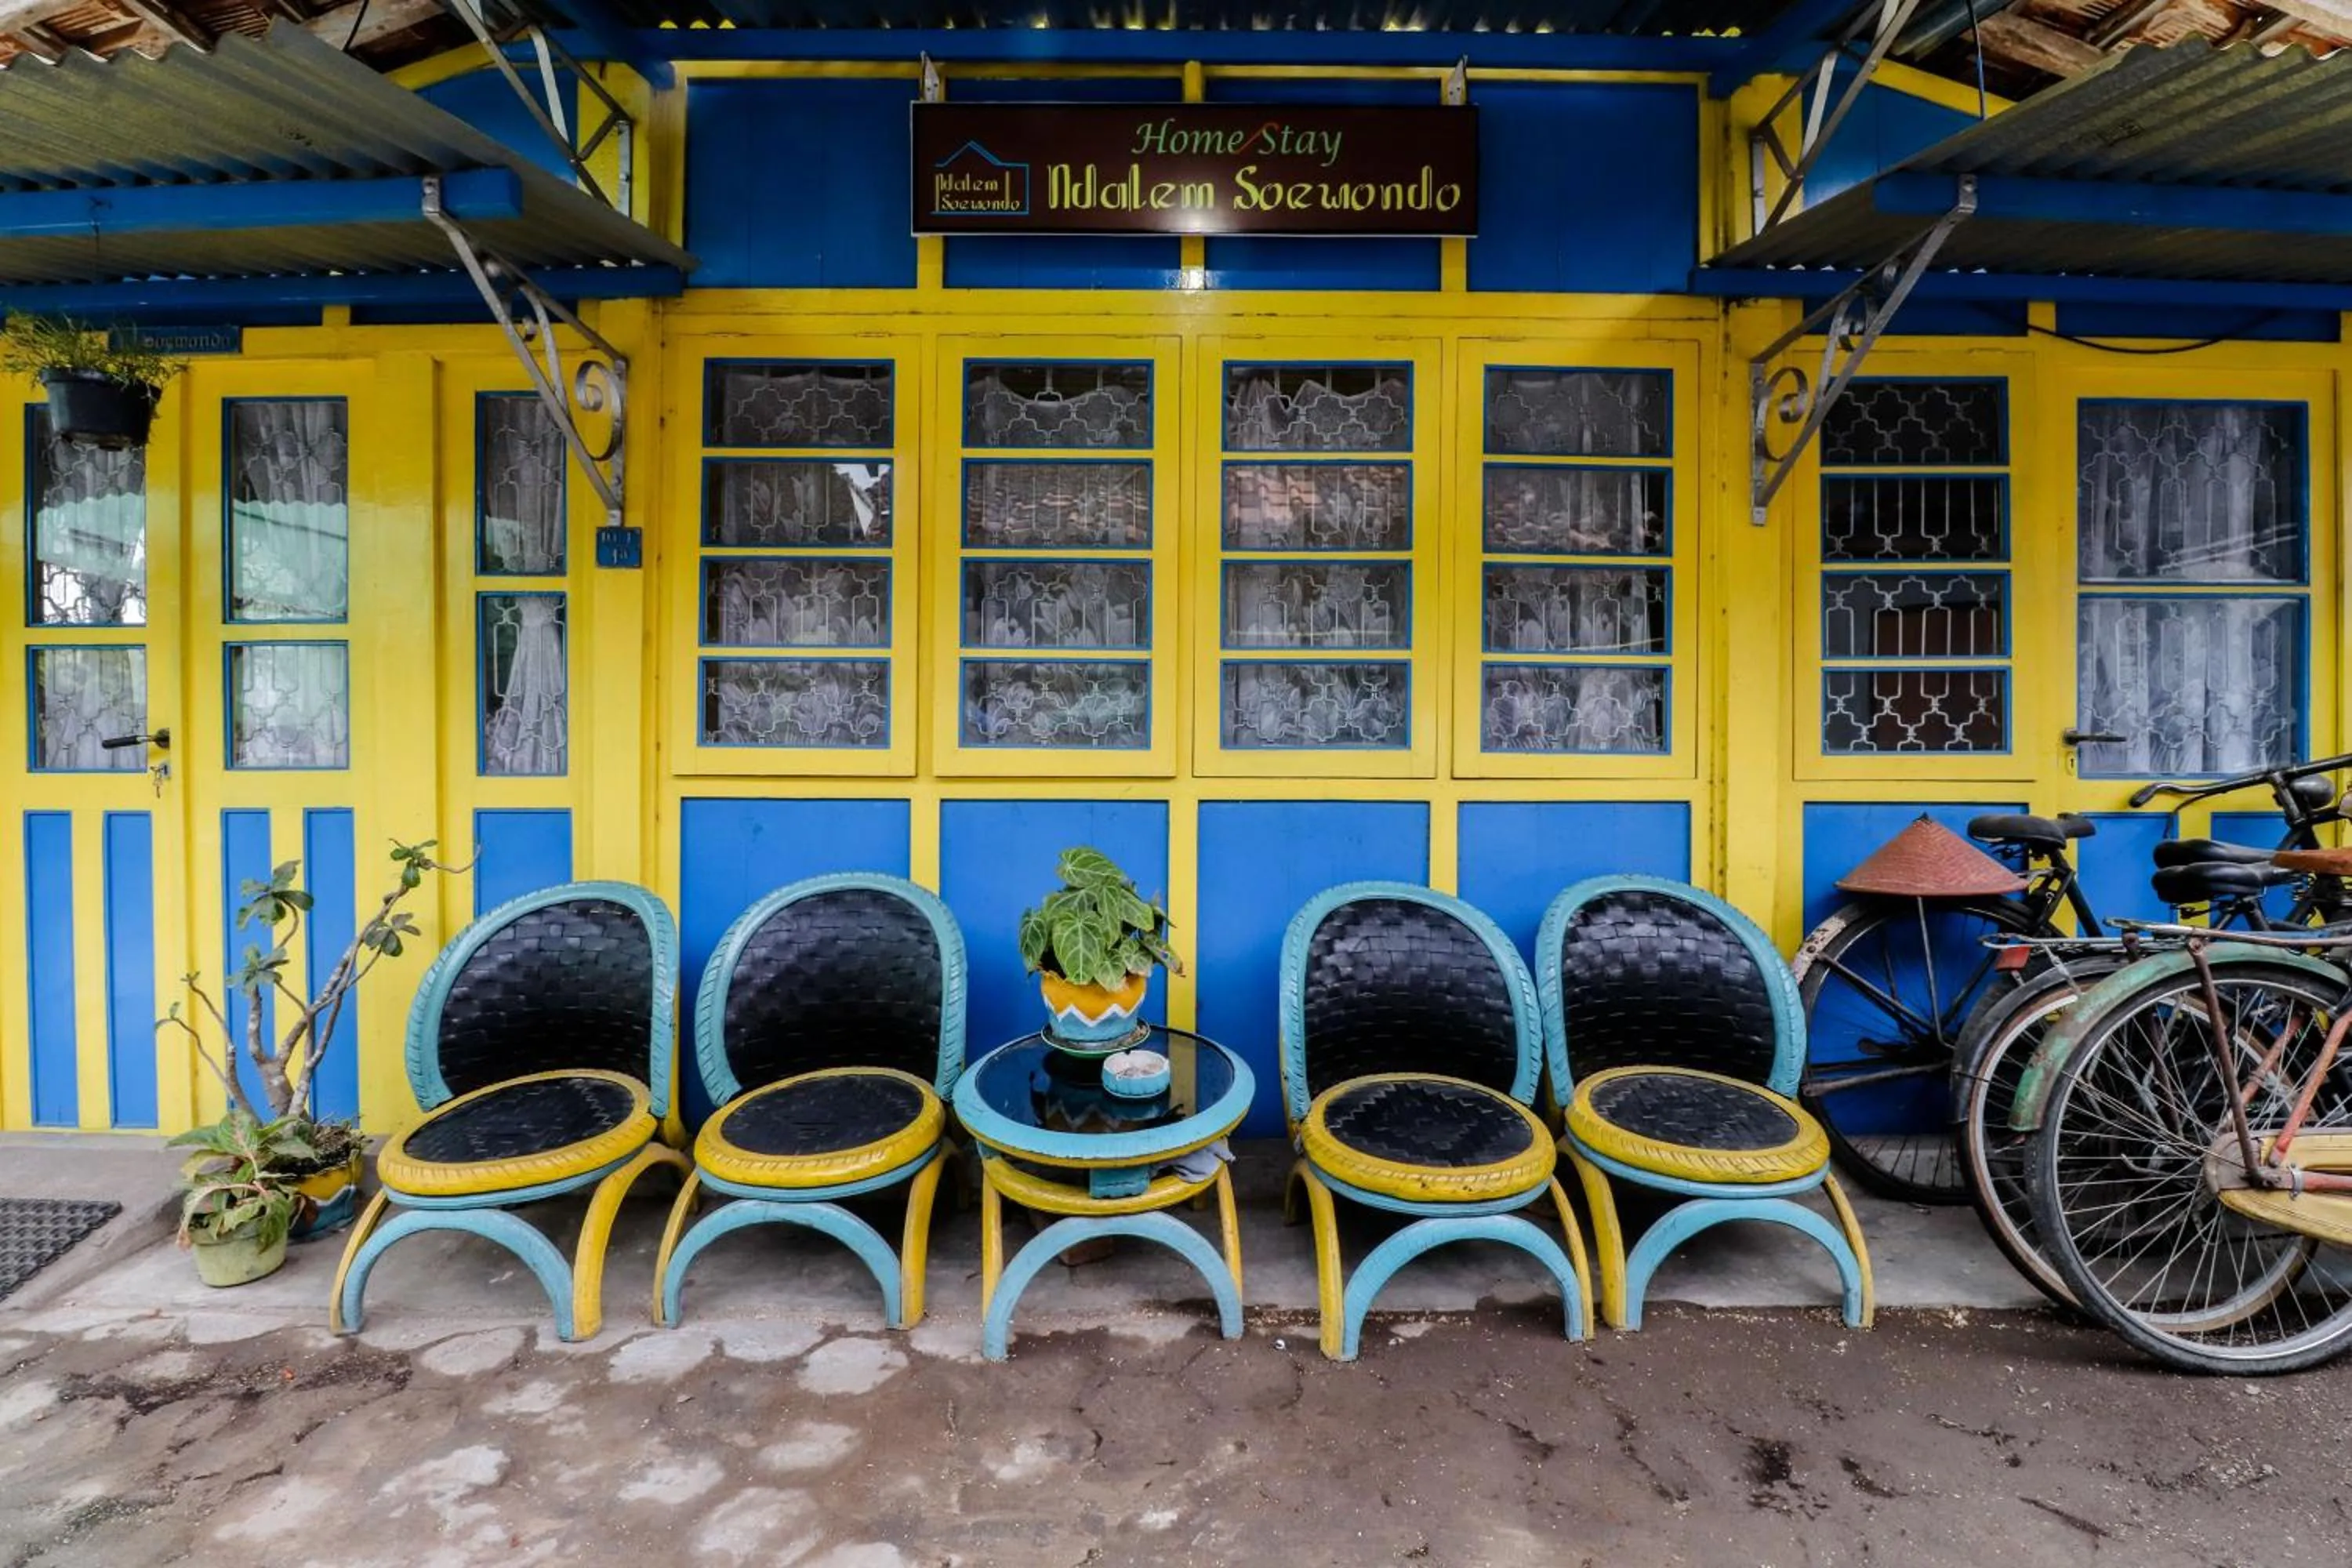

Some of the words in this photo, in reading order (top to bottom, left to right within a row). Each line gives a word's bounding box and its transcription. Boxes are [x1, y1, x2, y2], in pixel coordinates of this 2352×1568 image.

[1131, 118, 1245, 154] Home
[1257, 122, 1343, 167] Stay
[1047, 163, 1215, 211] Ndalem
[1233, 165, 1461, 212] Soewondo
